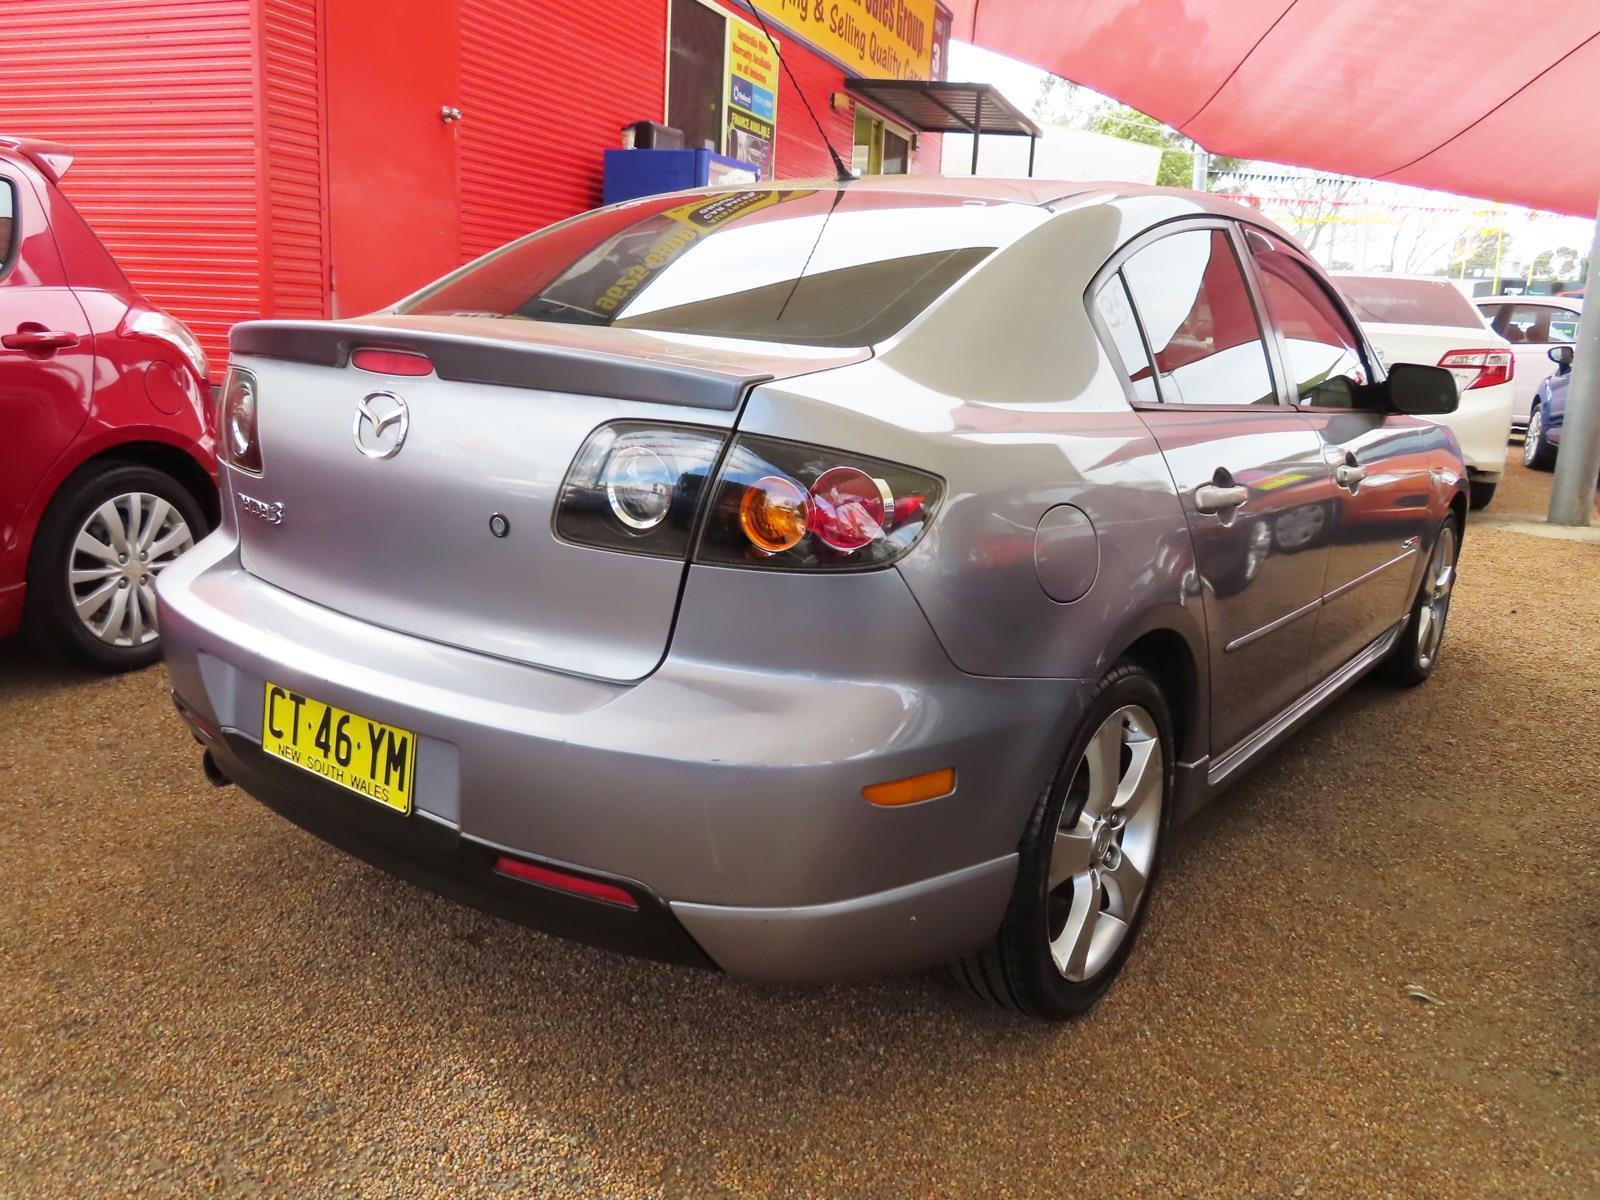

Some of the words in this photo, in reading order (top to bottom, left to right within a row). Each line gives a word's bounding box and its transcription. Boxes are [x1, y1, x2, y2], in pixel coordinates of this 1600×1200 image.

[830, 4, 866, 60] Selling
[869, 31, 901, 79] Quality
[277, 742, 301, 764] NEW
[306, 755, 345, 783] SOUTH
[350, 773, 389, 802] WALES
